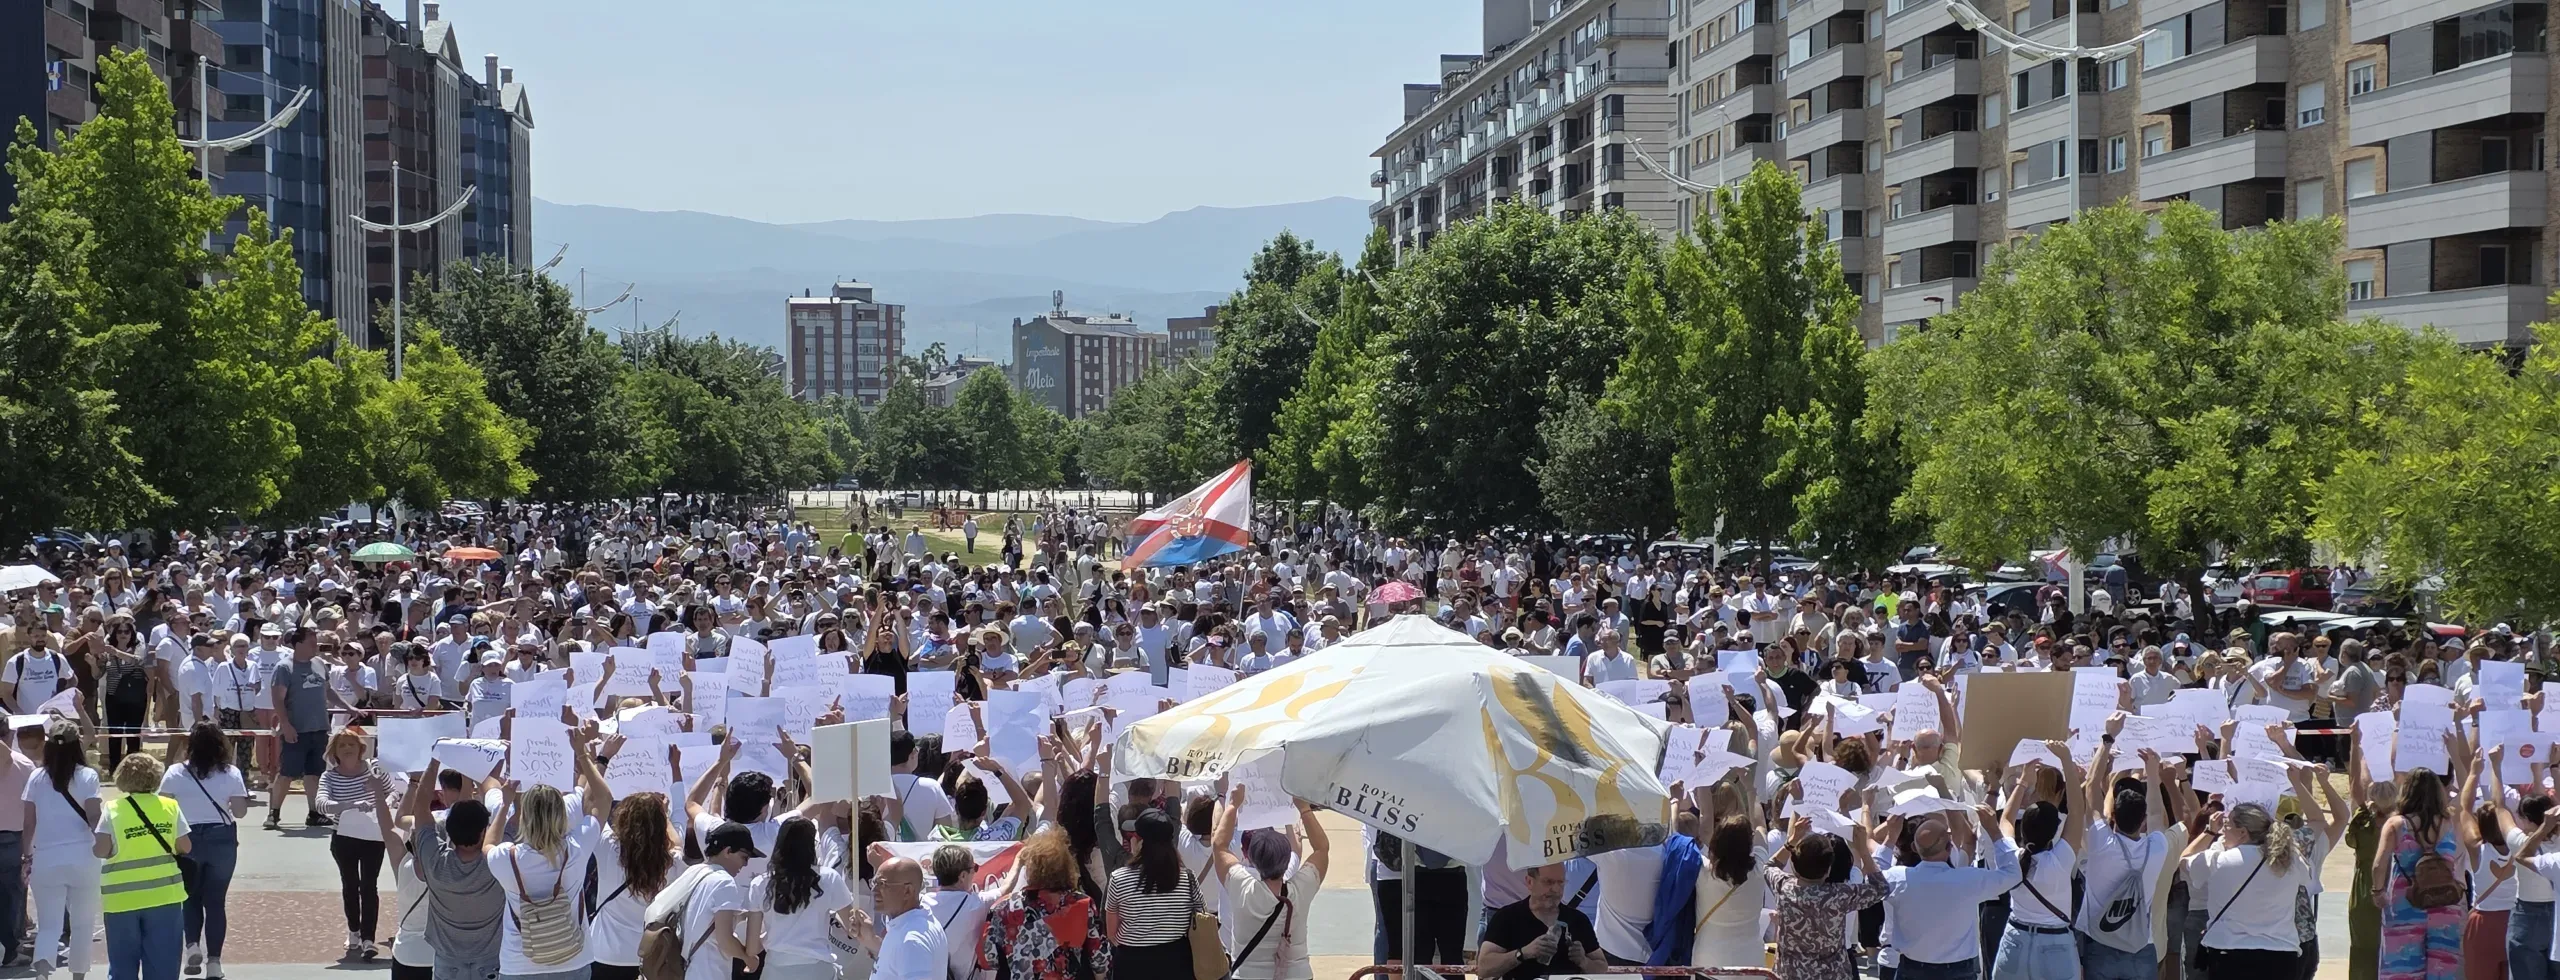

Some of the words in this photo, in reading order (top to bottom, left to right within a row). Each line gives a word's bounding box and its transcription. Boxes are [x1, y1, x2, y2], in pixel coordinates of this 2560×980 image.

[1024, 367, 1056, 390] Meta
[1360, 783, 1406, 808] ROYAL
[1335, 785, 1420, 833] BLISS
[1552, 820, 1588, 835] ROYAL
[1543, 828, 1606, 858] BLISS
